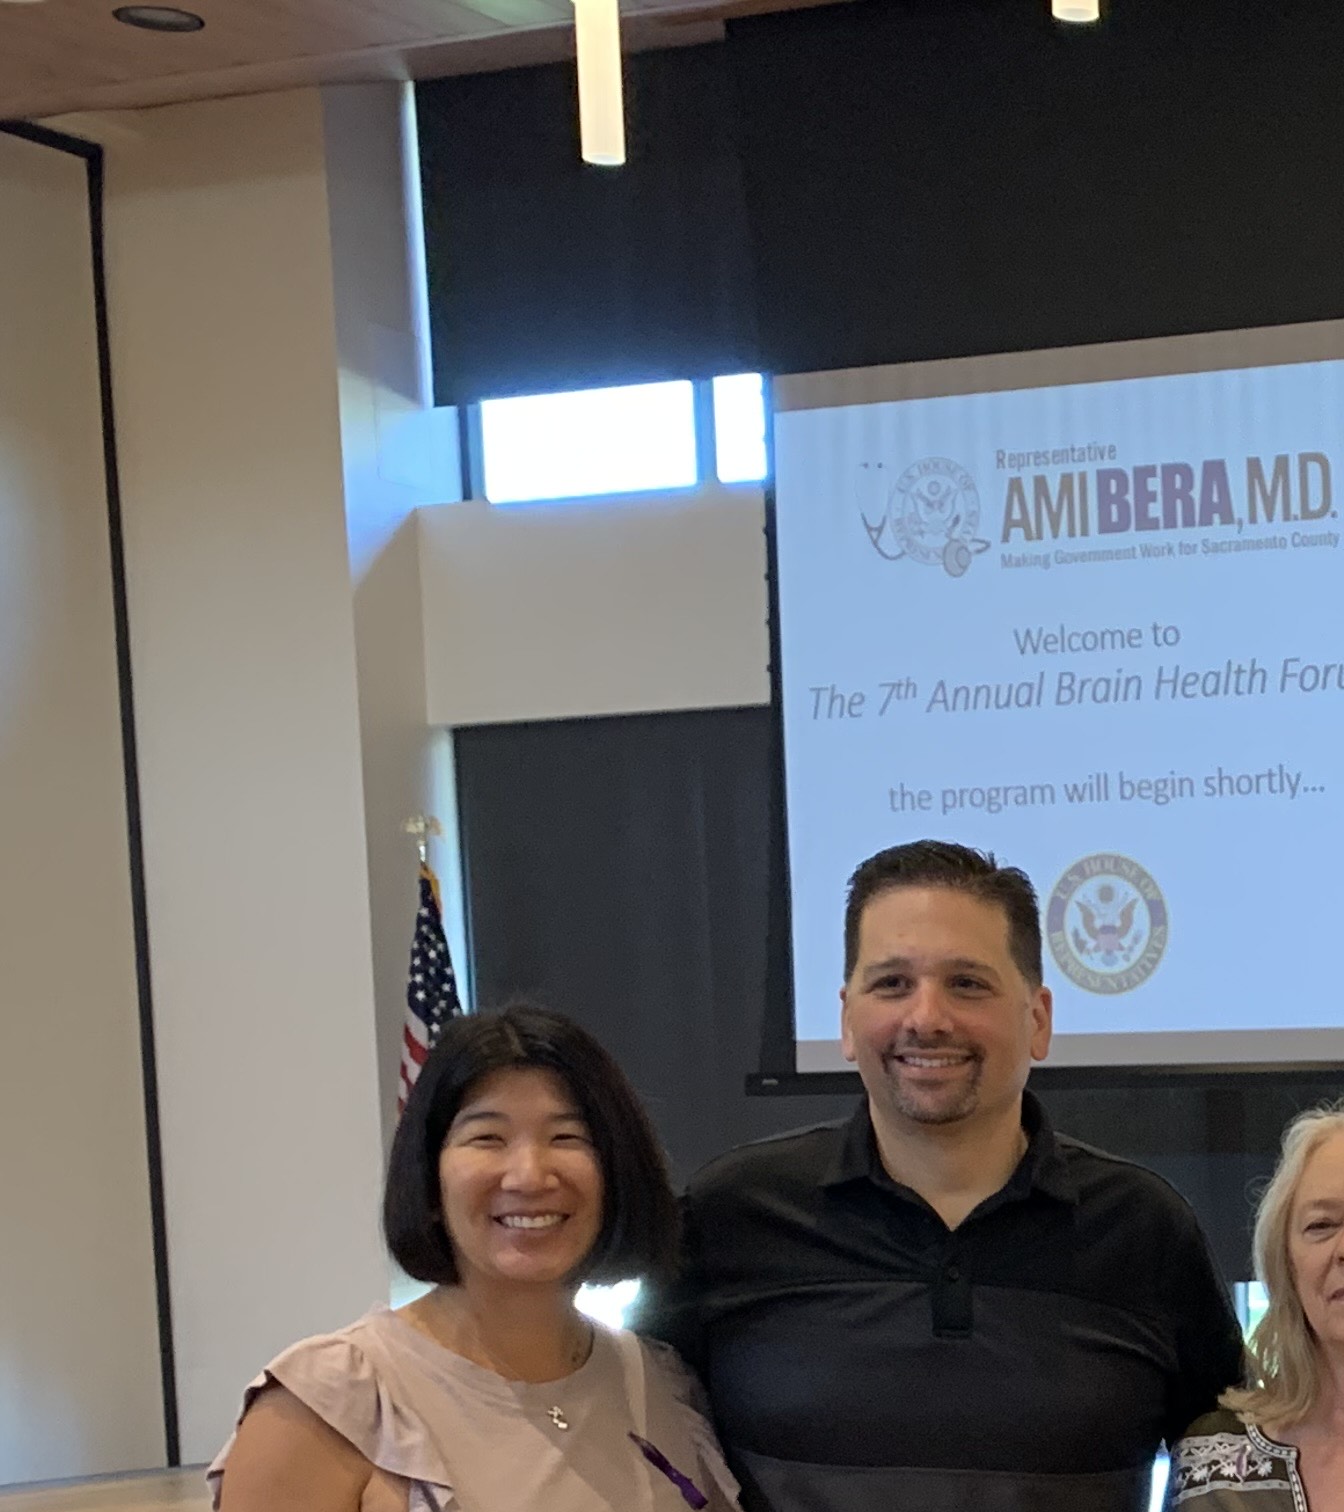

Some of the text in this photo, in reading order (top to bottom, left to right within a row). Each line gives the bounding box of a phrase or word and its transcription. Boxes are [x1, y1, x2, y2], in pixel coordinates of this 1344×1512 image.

[996, 442, 1117, 470] Representative
[1246, 452, 1338, 525] M.D.
[1001, 530, 1340, 570] Making Government Work for Sacramento County
[1014, 621, 1180, 655] Welcome to
[809, 685, 865, 720] The
[878, 677, 917, 716] 7th
[926, 671, 1045, 713] Annual
[1055, 668, 1143, 706] Brain
[1154, 659, 1266, 700] Health
[889, 764, 1325, 816] the program will begin shortly...
